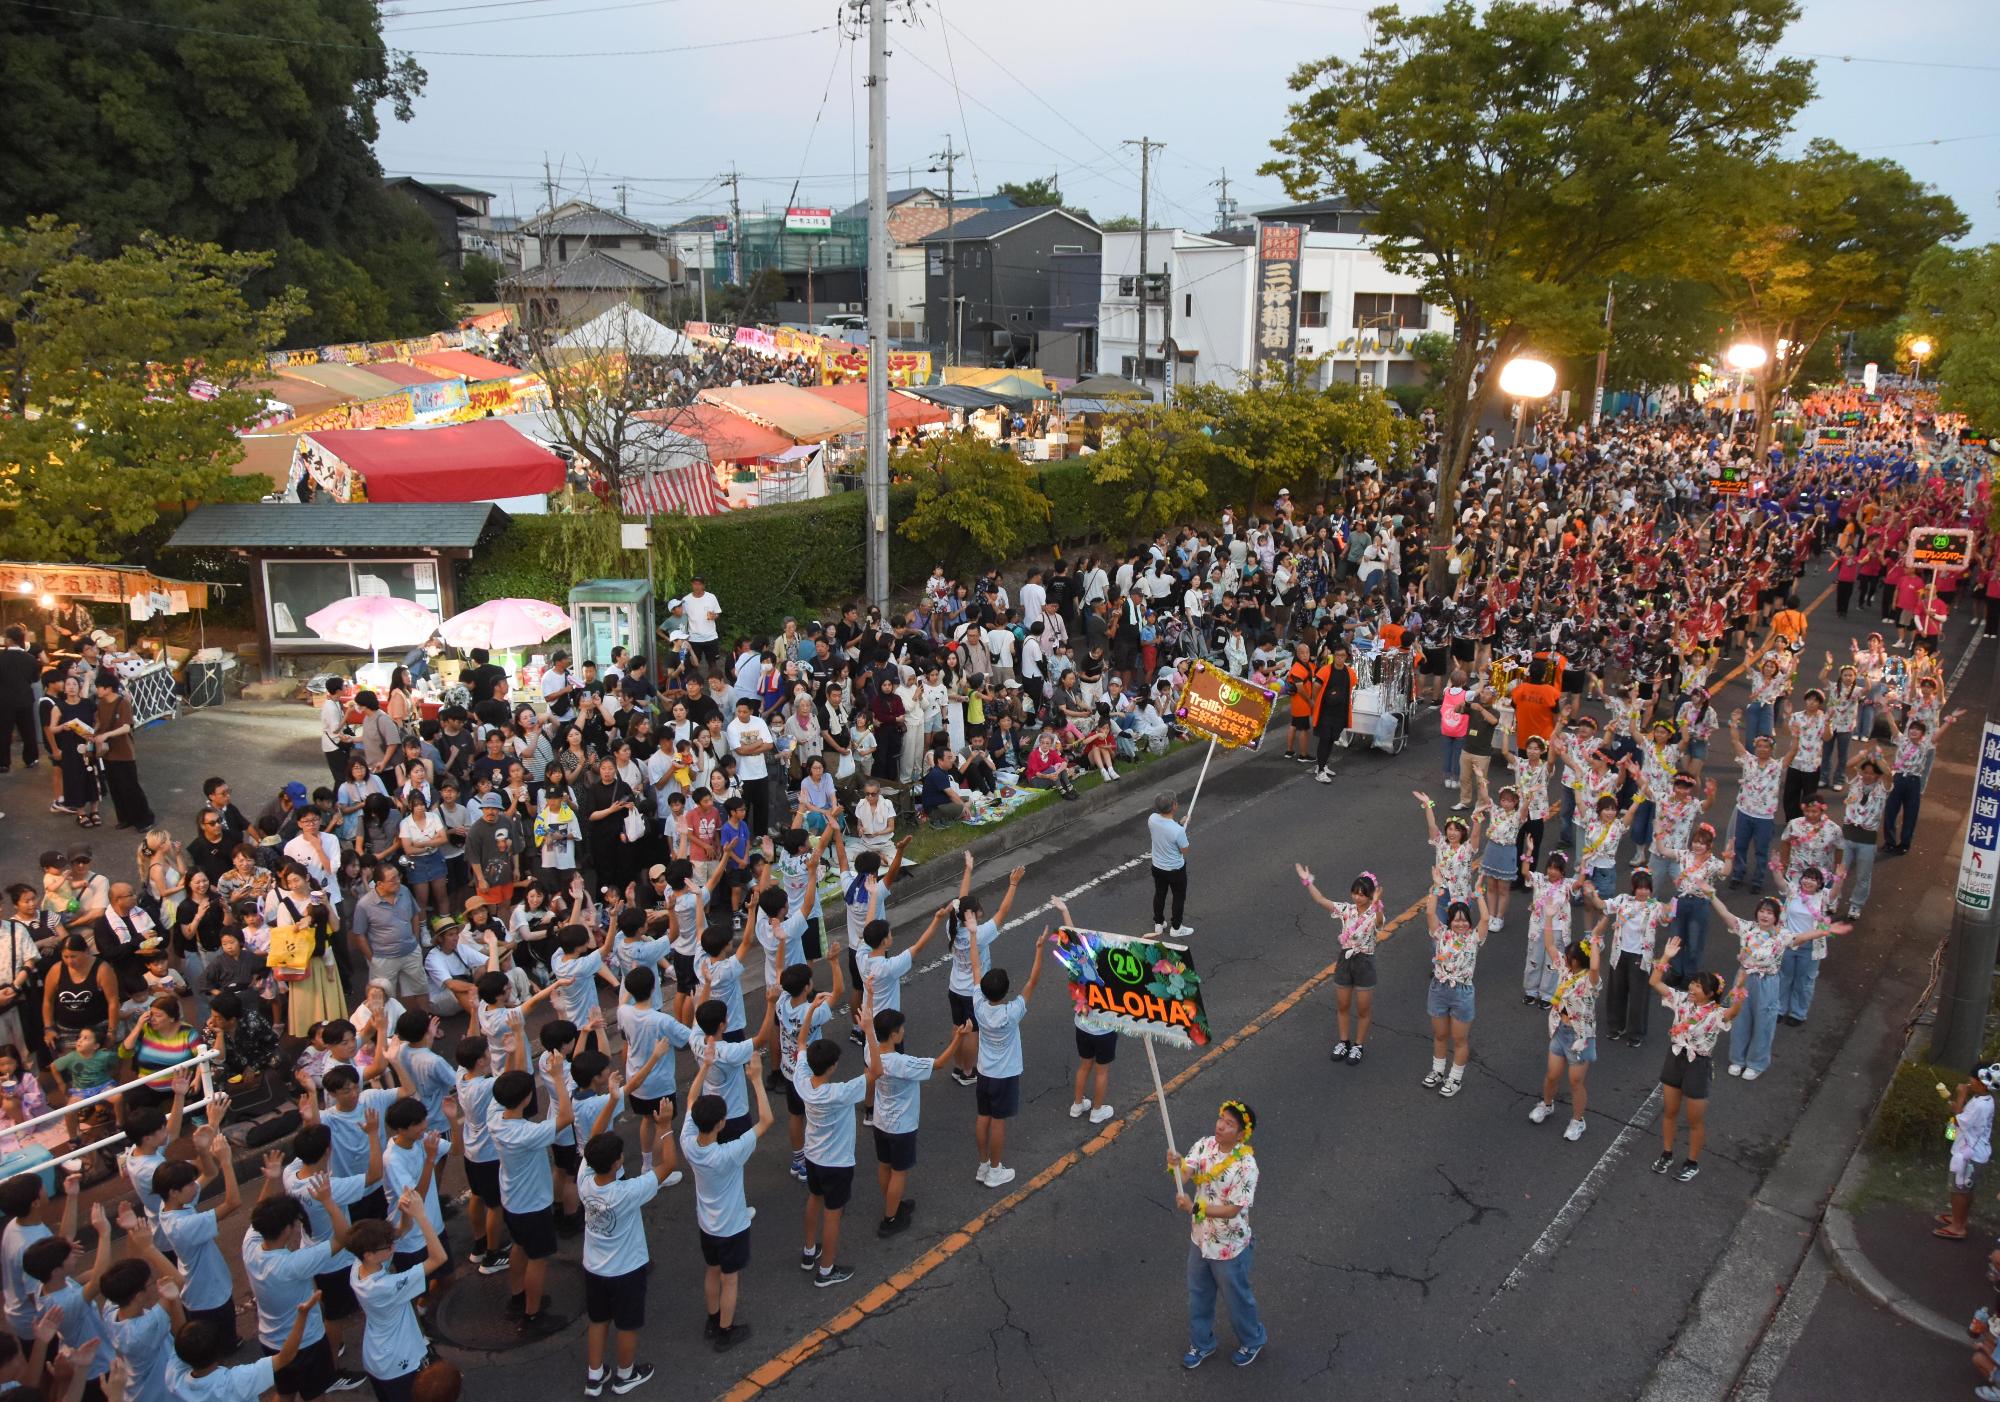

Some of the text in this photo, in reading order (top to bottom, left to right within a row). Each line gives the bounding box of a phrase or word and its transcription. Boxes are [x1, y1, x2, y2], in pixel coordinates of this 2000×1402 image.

[1188, 705, 1251, 740] 三好中3年生
[1189, 691, 1259, 729] Trailblazers
[1113, 953, 1139, 977] 24
[1088, 984, 1192, 1027] ALOHA
